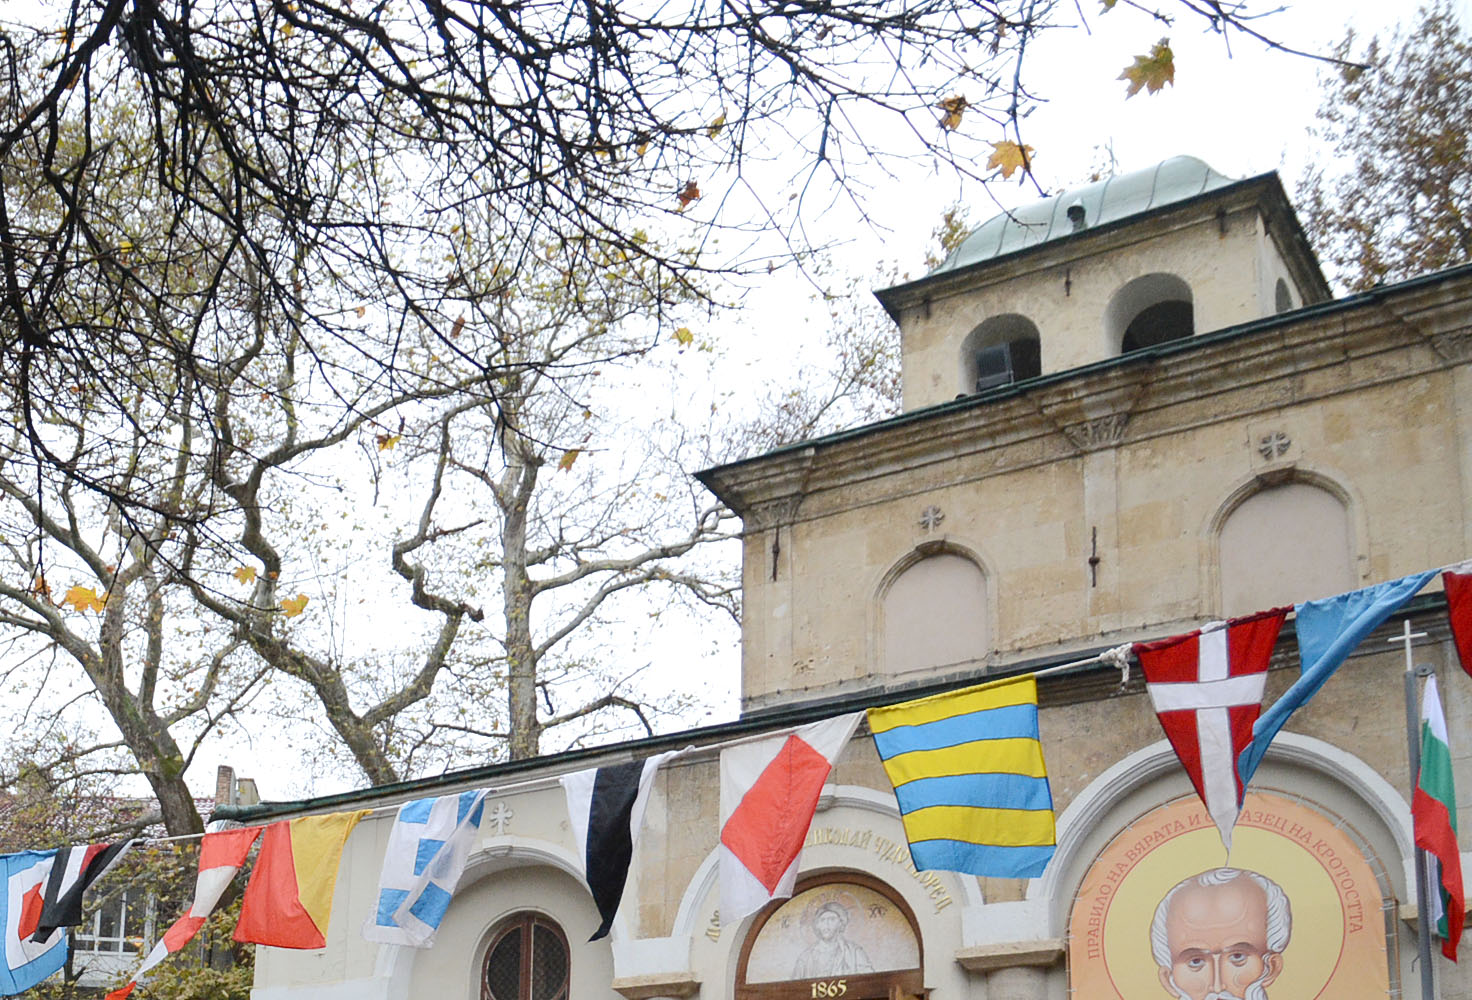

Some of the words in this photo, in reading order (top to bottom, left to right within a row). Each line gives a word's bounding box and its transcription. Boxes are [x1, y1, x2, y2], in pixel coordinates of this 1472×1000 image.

[1087, 883, 1113, 960] ПРАВИЛО
[1106, 861, 1128, 884] НА
[1125, 820, 1186, 862] ВЯРАТА
[1188, 813, 1201, 826] И
[1288, 823, 1313, 844] НА
[1312, 839, 1364, 934] КРОТОСТТА
[811, 979, 847, 999] 1865
